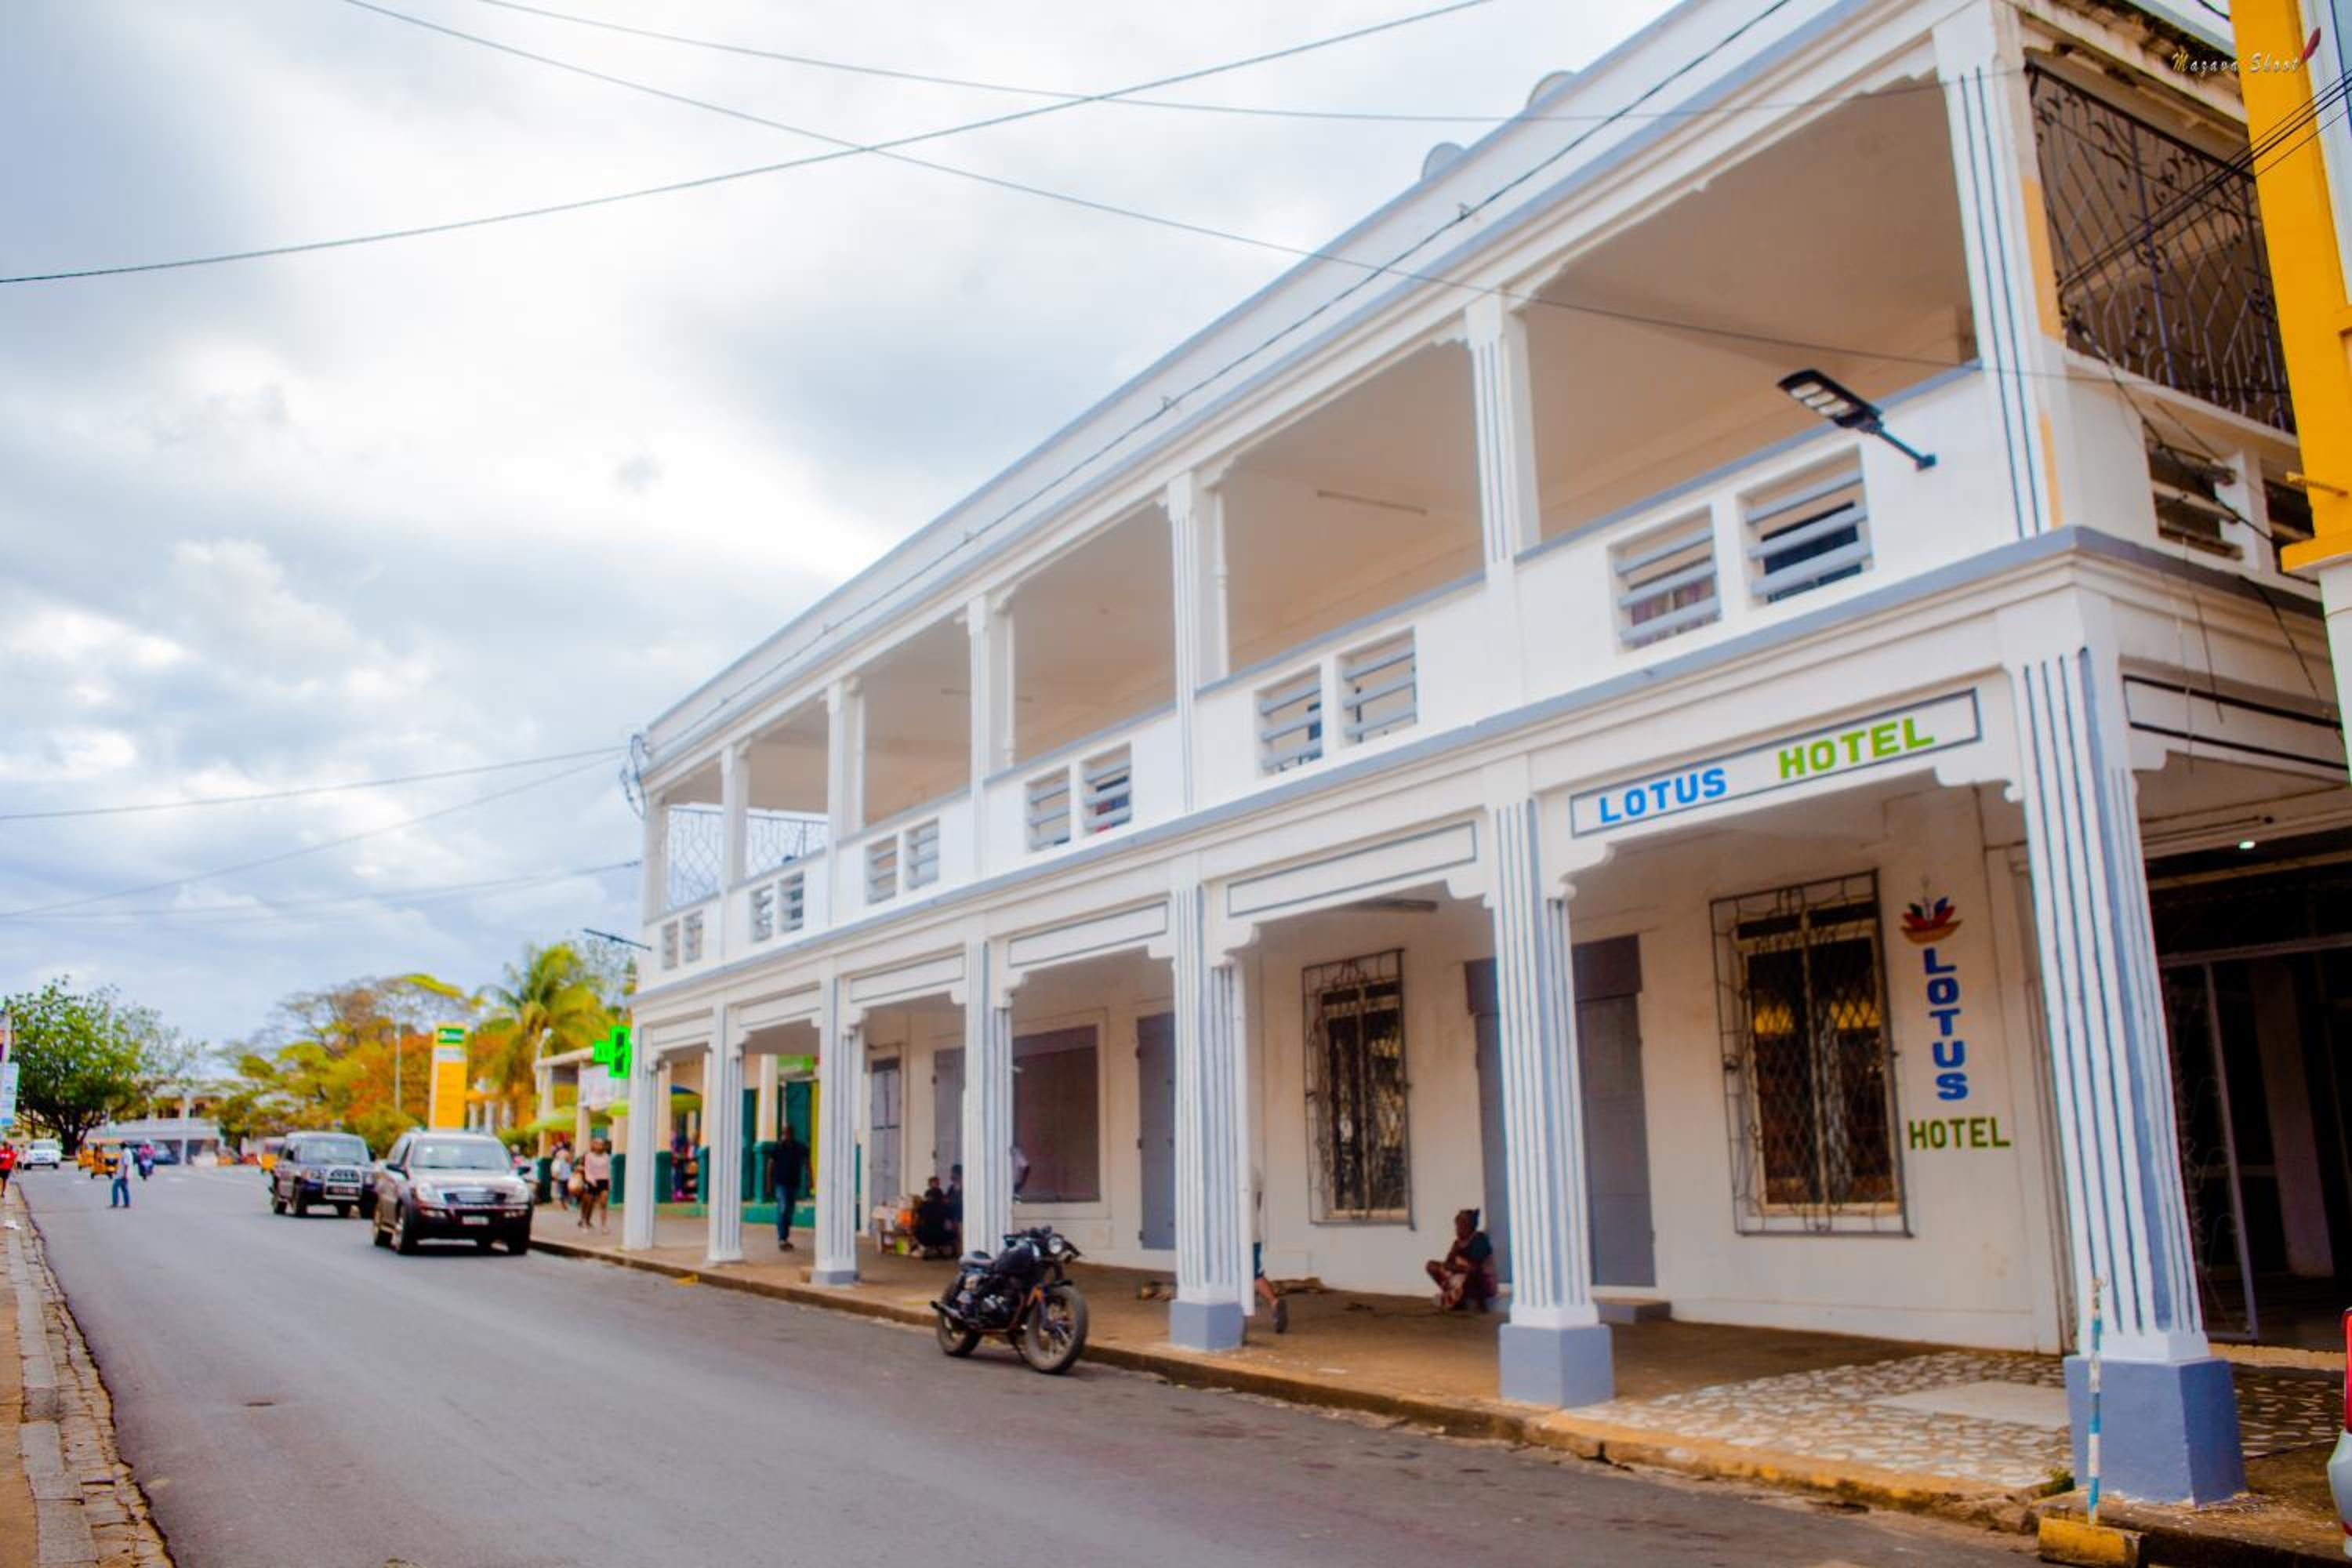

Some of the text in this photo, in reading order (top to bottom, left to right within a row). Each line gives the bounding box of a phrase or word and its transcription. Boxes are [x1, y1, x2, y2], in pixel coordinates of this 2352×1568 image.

[1599, 717, 1935, 824] LOTUS HOTEL
[1923, 946, 1969, 1101] LOTUS
[1907, 1116, 2011, 1150] HOTEL
